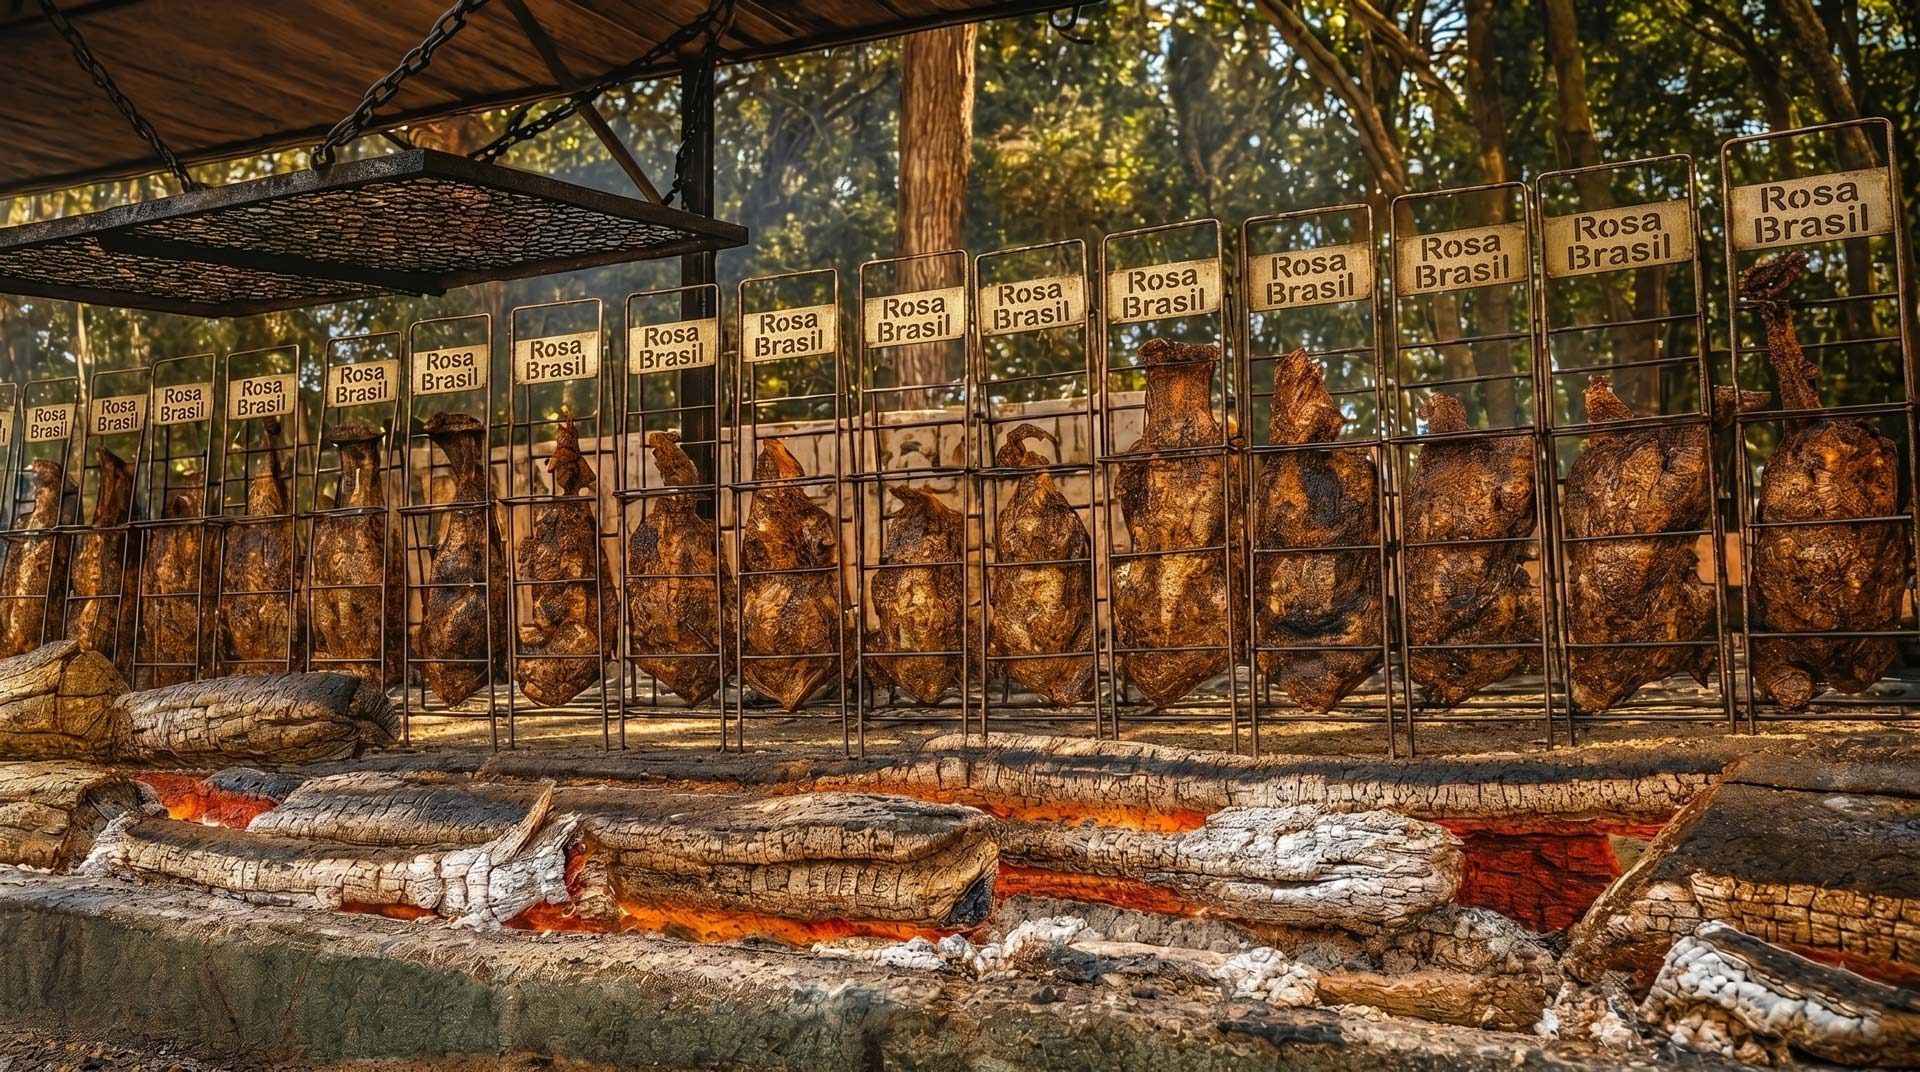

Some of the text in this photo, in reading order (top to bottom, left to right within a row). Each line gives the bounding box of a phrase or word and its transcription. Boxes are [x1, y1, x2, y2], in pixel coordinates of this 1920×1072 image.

[1761, 182, 1859, 213] Rosa
[1574, 212, 1661, 242] Rosa
[1754, 203, 1869, 243] Brasil
[1421, 234, 1501, 262] Rosa
[1567, 233, 1670, 270] Brasil
[1272, 254, 1346, 280] Rosa
[1415, 254, 1509, 289] Brasil
[1128, 268, 1198, 294] Rosa
[1266, 272, 1354, 305] Brasil
[998, 282, 1062, 307] Rosa
[1122, 287, 1205, 318] Brasil
[883, 297, 945, 320] Rosa
[993, 300, 1069, 330] Brasil
[760, 312, 818, 335] Rosa
[878, 313, 950, 343] Brasil
[645, 326, 699, 348] Rosa
[755, 330, 823, 357] Brasil
[427, 352, 474, 371] Rosa
[530, 339, 582, 360] Rosa
[640, 342, 703, 369] Brasil
[341, 366, 384, 385] Rosa
[422, 367, 478, 391] Brasil
[526, 355, 586, 380] Brasil
[165, 389, 201, 404] Rosa
[242, 379, 282, 397] Rosa
[336, 381, 387, 403] Brasil
[35, 408, 66, 422] Rosa
[102, 400, 136, 415] Rosa
[161, 401, 204, 421] Brasil
[238, 394, 285, 416] Brasil
[31, 420, 67, 439] Brasil
[98, 412, 138, 432] Brasil
